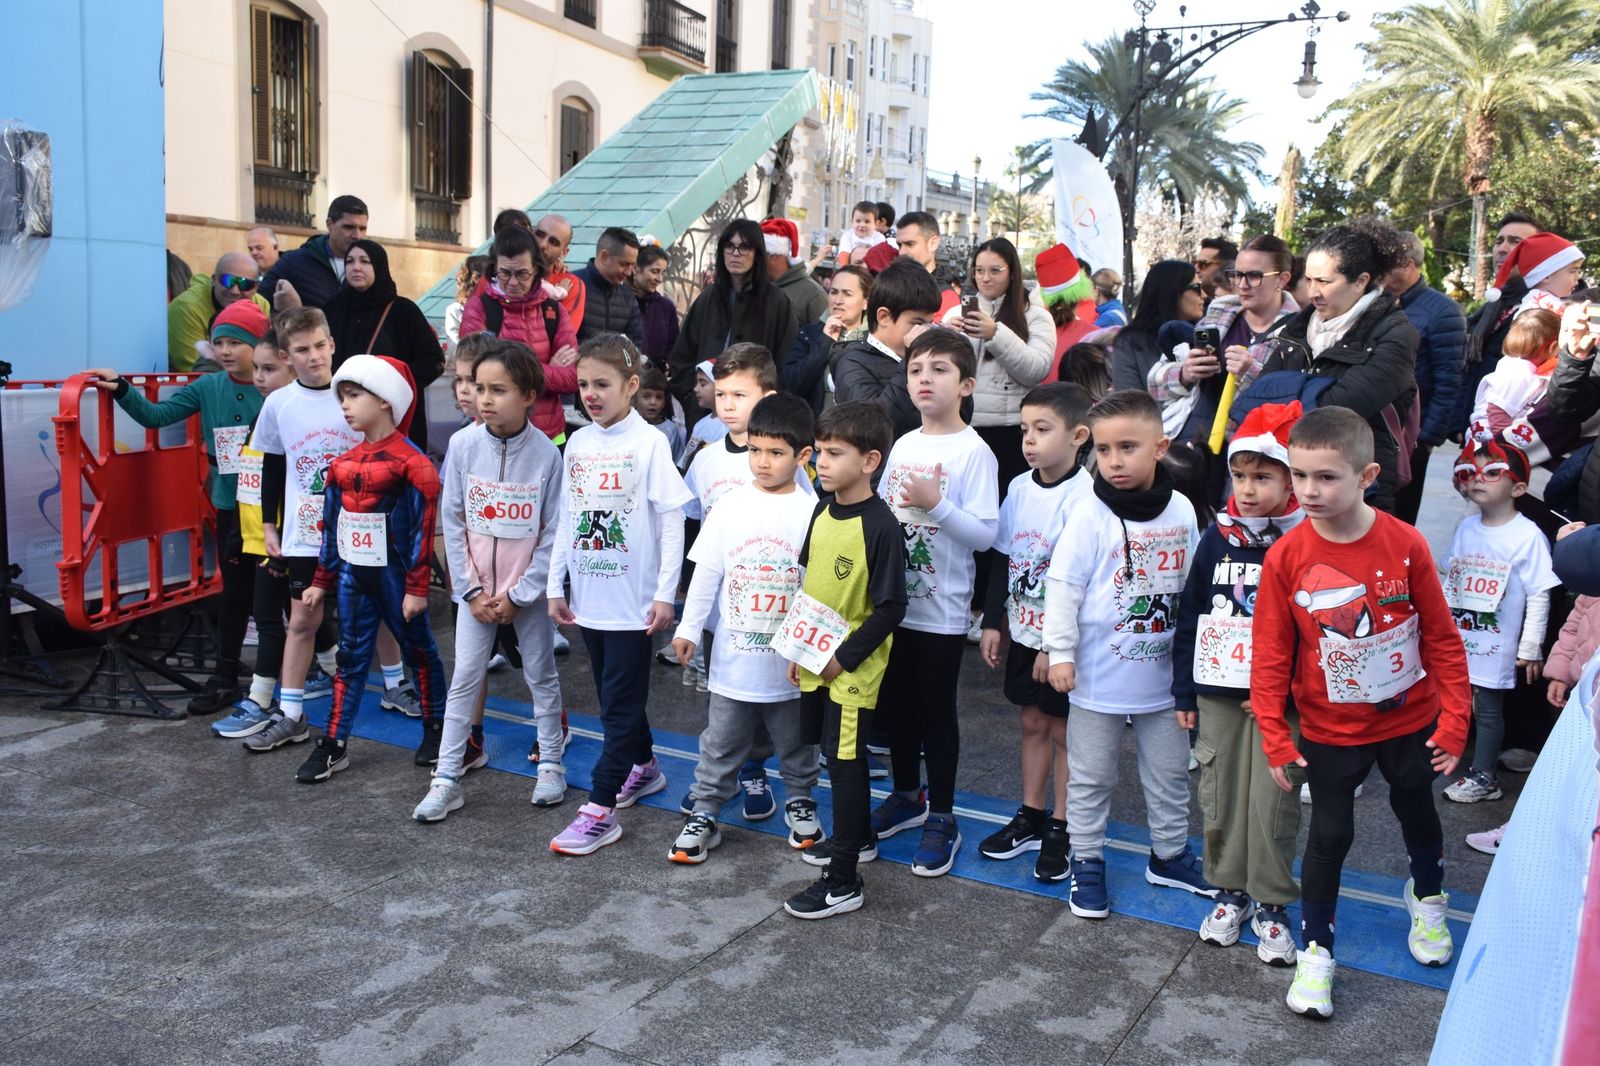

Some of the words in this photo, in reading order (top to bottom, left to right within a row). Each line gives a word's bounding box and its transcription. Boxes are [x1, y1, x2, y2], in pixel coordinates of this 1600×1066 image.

[599, 472, 622, 490] 21
[496, 501, 533, 520] 500
[352, 532, 373, 548] 84
[1157, 548, 1185, 571] 217
[1212, 562, 1264, 586] MER
[1464, 576, 1499, 595] 108
[751, 594, 788, 613] 171
[792, 620, 834, 653] 616
[1389, 652, 1404, 673] 3
